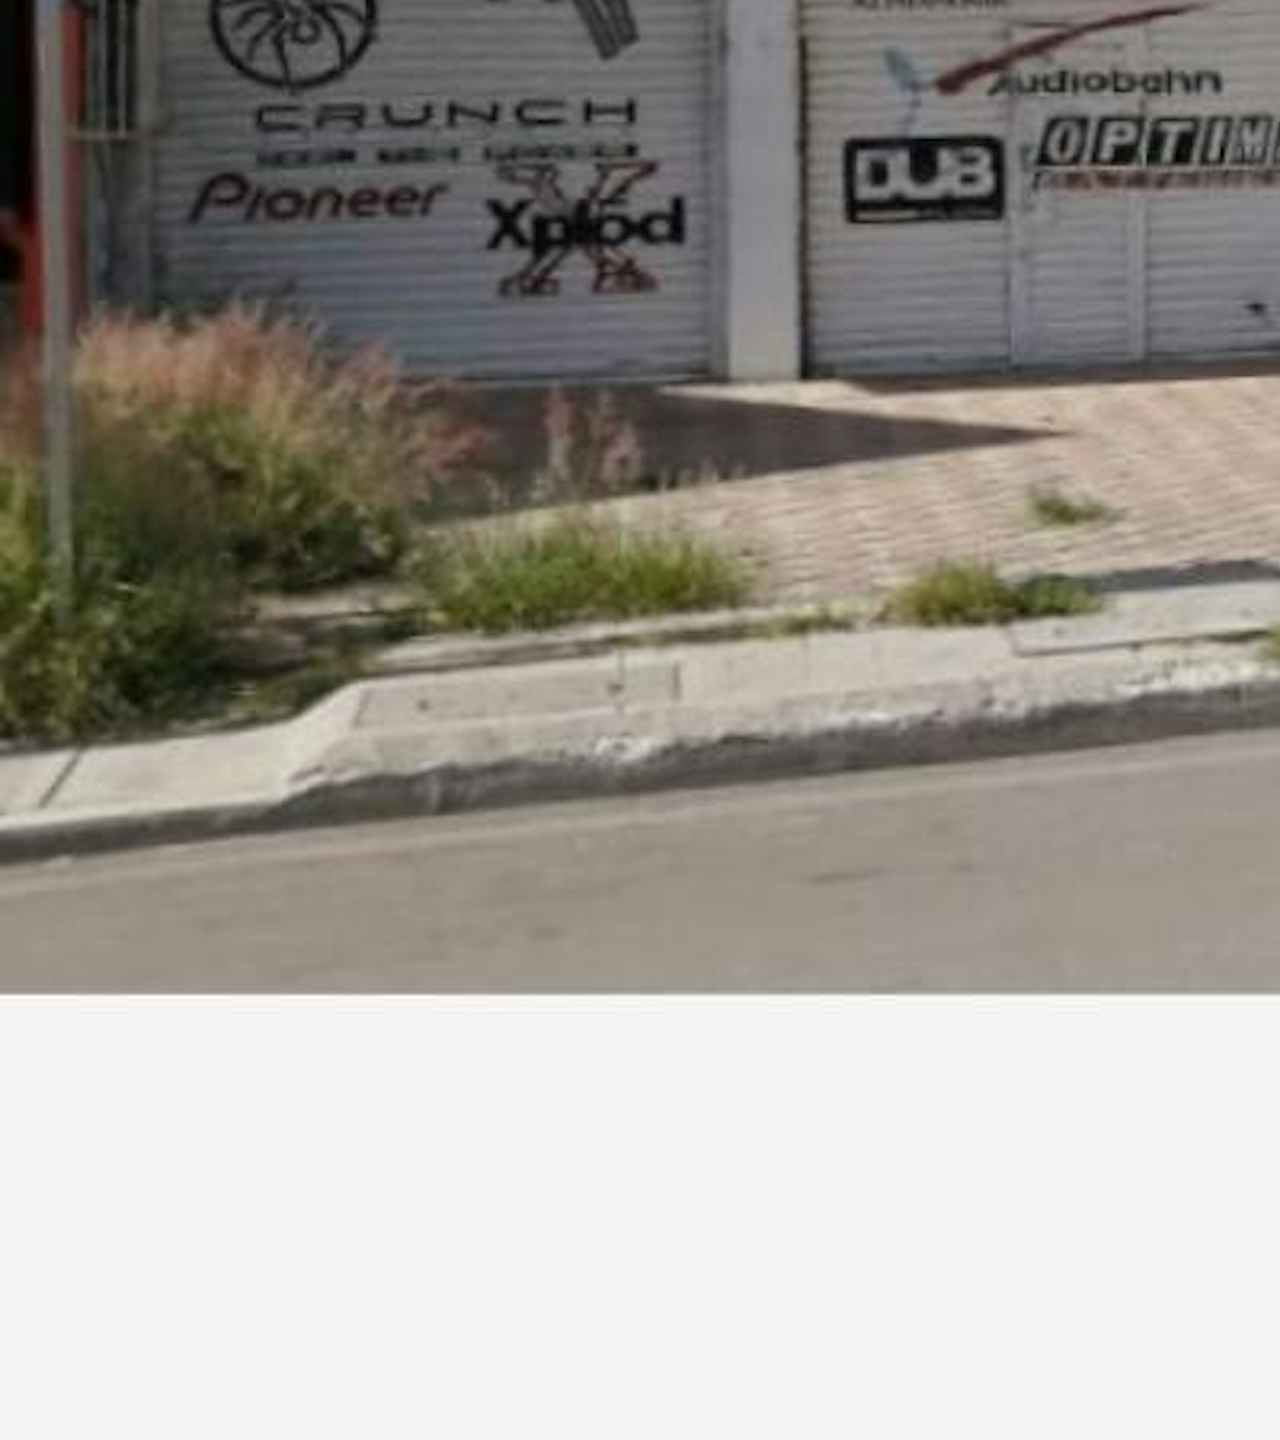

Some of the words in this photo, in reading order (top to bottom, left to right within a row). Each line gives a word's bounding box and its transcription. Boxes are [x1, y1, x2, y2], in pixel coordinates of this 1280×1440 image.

[988, 68, 1223, 97] Audiobahn
[256, 100, 638, 132] CRUNCH
[188, 172, 450, 223] Pioneer
[856, 148, 999, 201] DUB
[486, 197, 687, 257] Xplod
